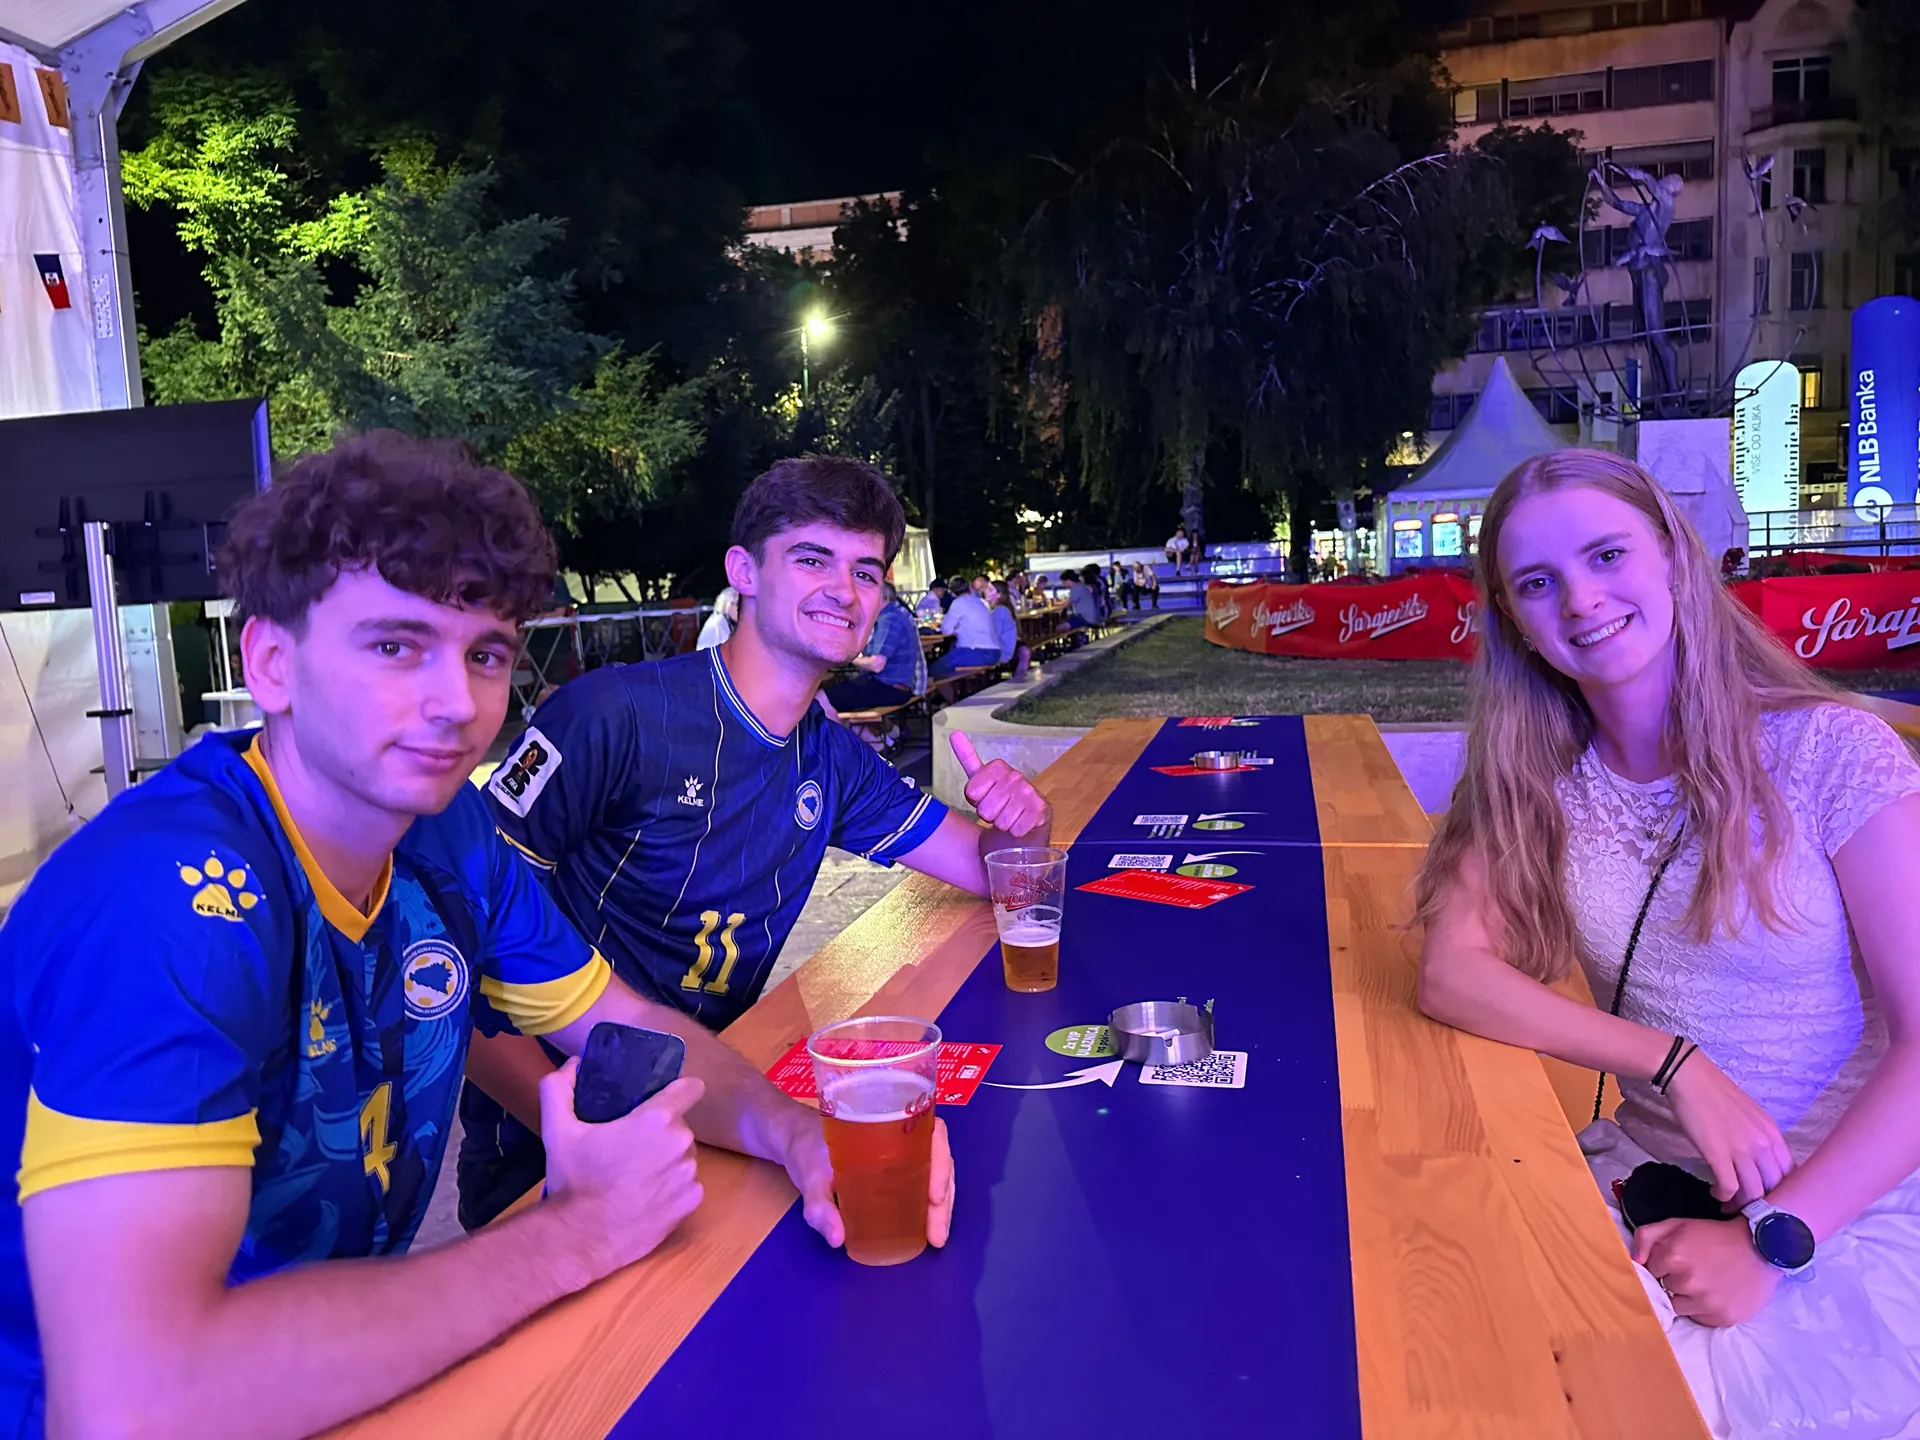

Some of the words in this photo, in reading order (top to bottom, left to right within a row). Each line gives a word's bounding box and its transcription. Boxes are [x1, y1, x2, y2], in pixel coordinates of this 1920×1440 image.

[1751, 403, 1762, 432] KLIKA
[1855, 369, 1878, 436] Banka
[1751, 433, 1762, 449] OD
[1751, 452, 1762, 475] VIŠE
[1858, 437, 1882, 483] NLB
[1794, 596, 1920, 659] Saraj
[677, 794, 704, 807] KELME
[680, 909, 747, 997] 11
